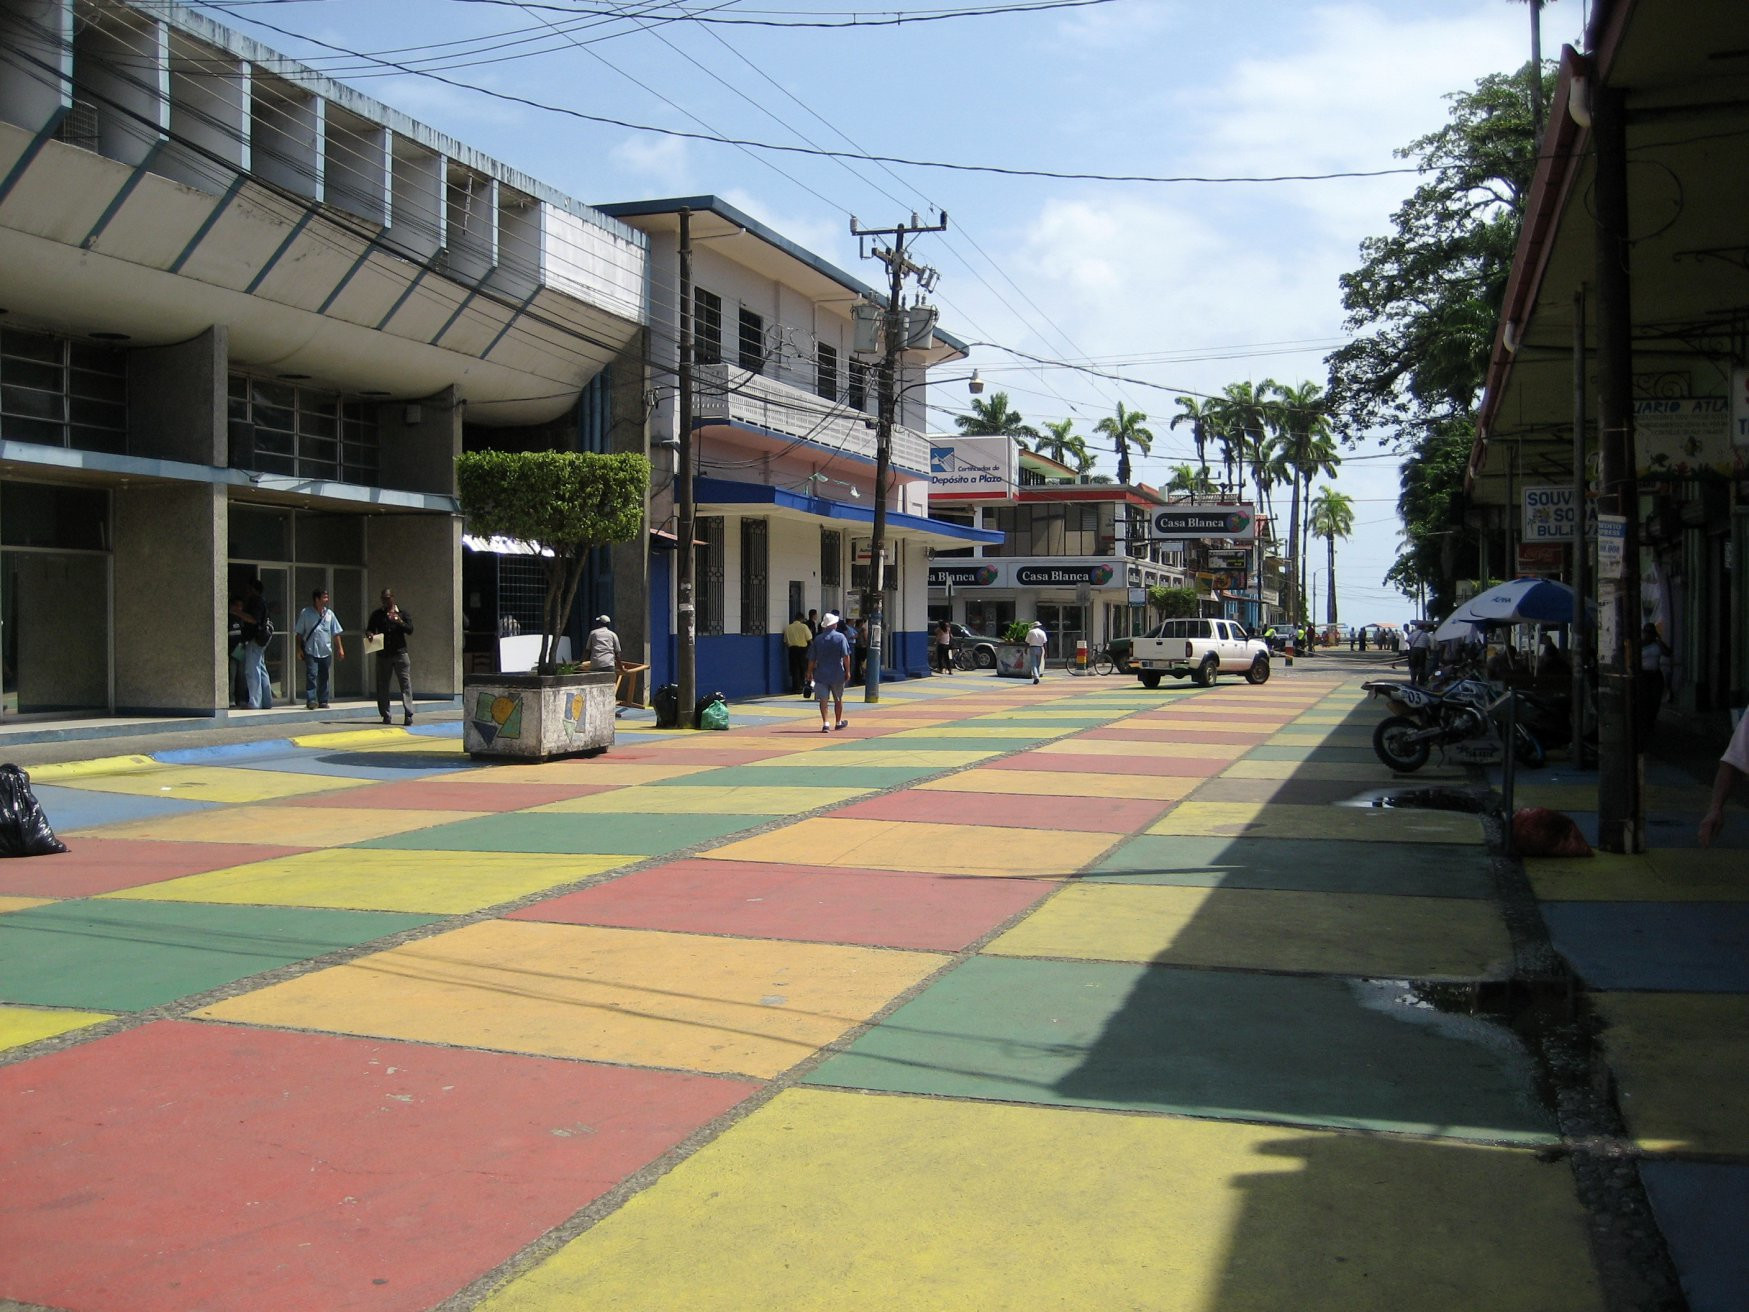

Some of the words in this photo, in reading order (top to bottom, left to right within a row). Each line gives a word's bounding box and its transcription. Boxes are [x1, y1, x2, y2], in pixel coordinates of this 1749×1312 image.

[931, 474, 969, 486] Depósito
[978, 474, 1002, 484] Plazo
[1554, 508, 1599, 522] SOA
[1160, 517, 1186, 528] Casa
[1187, 517, 1225, 528] Blanca
[937, 571, 975, 582] Blanca
[1022, 571, 1049, 582] Casa
[1051, 571, 1090, 582] Blanca
